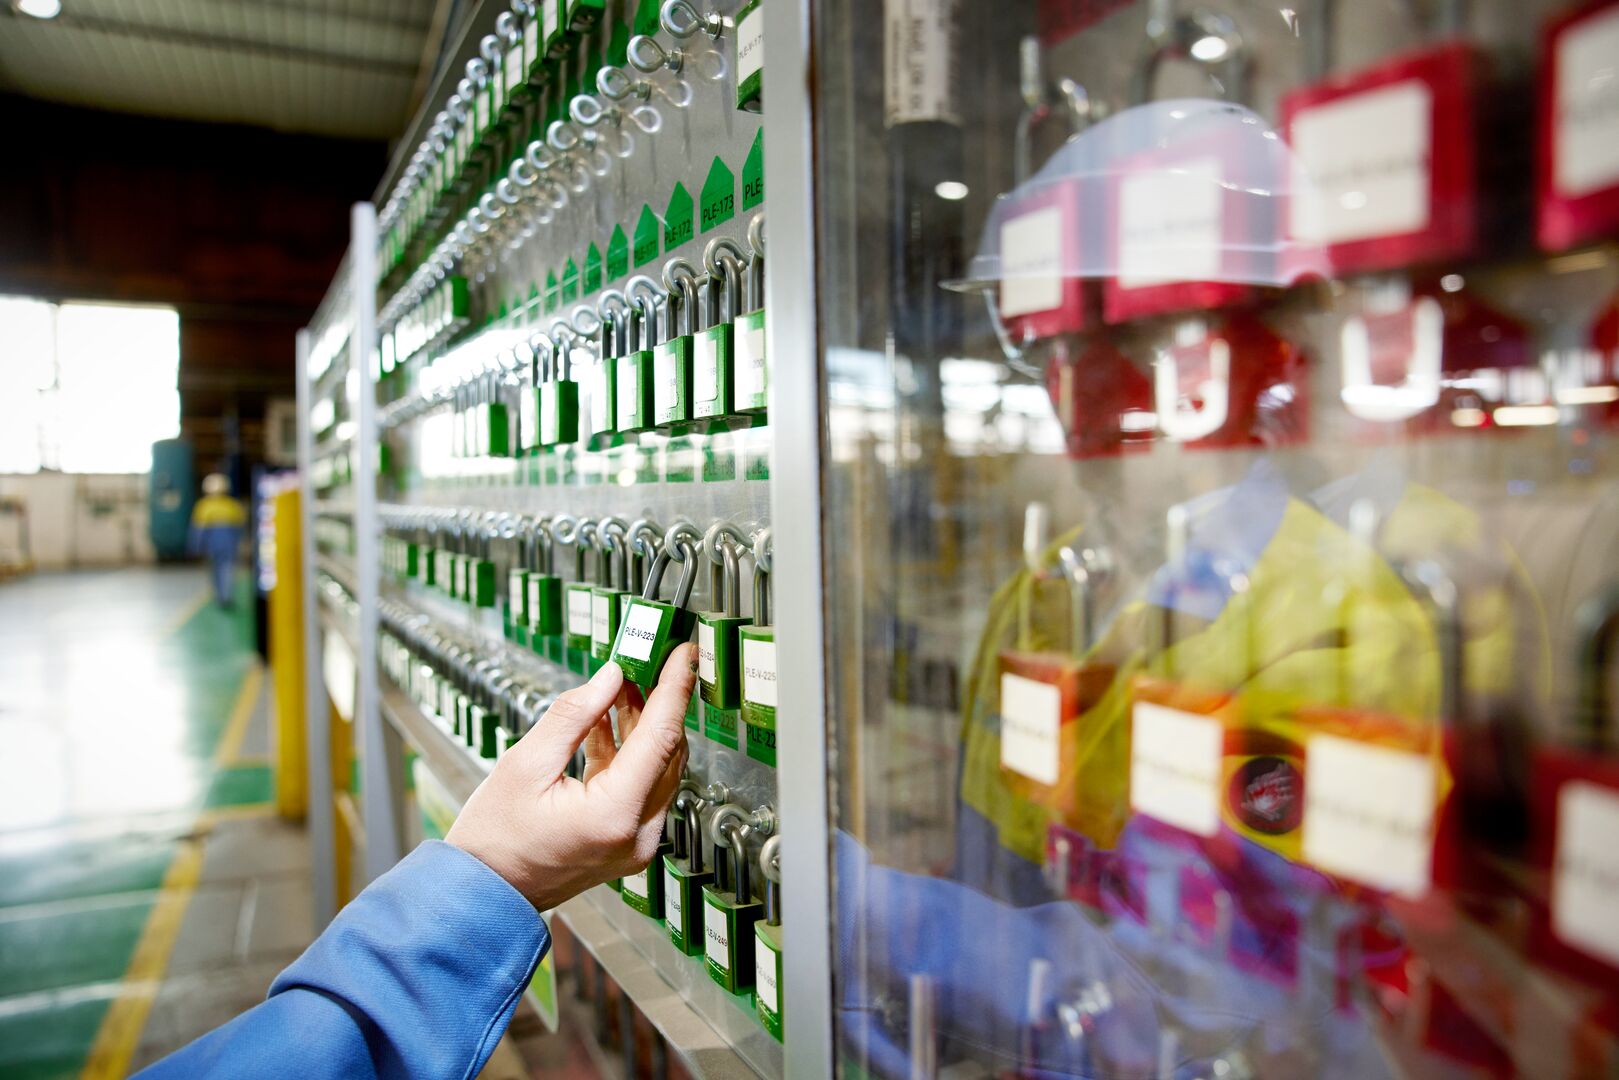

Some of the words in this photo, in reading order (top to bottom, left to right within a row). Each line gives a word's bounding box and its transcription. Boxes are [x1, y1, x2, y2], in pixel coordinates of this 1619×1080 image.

[703, 194, 734, 223] PLE-173
[665, 219, 691, 243] PLE-172
[624, 627, 655, 641] PLE-V-223
[745, 667, 776, 681] PLE-V-225
[705, 706, 735, 731] PLE-223
[706, 925, 728, 947] PLE-V-249
